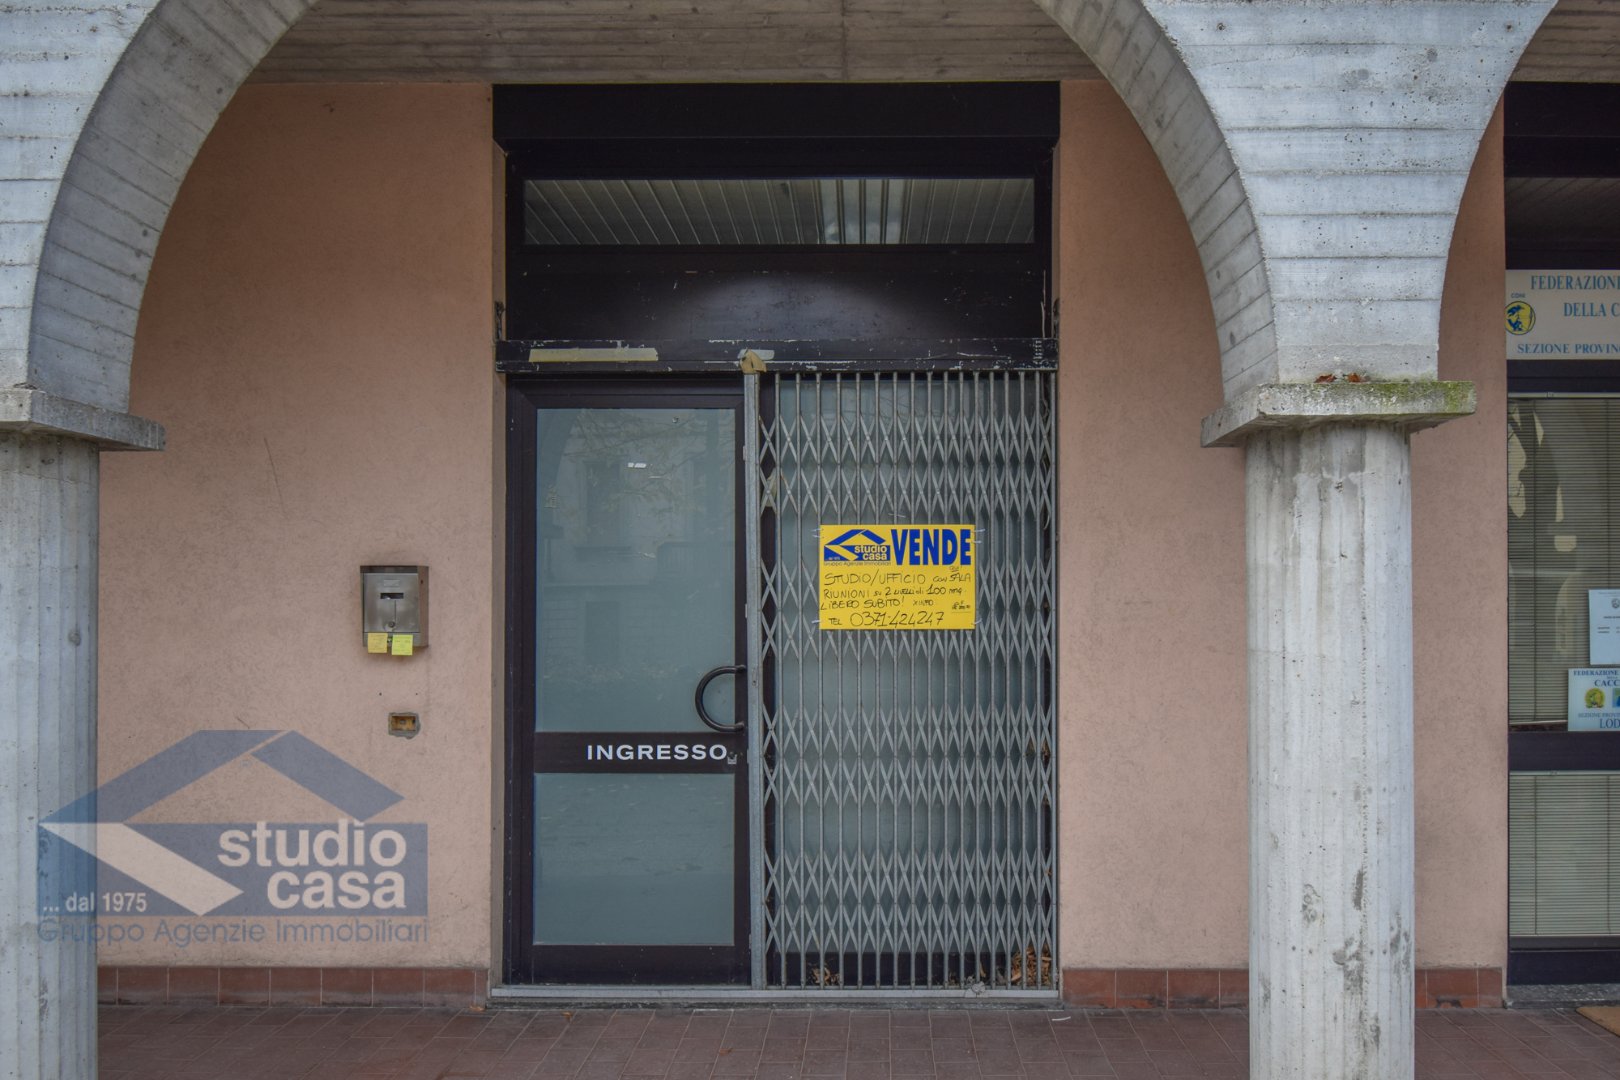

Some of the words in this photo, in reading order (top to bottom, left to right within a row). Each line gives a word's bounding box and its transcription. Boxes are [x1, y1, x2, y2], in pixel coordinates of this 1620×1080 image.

[1563, 302, 1607, 317] DELLA
[1517, 343, 1570, 354] SEZIONE
[1574, 343, 1620, 354] PROVIN
[854, 545, 888, 554] studio
[890, 528, 971, 566] VENDE
[862, 553, 888, 561] casa
[823, 588, 870, 600] RIUNIONI
[885, 587, 891, 596] 2
[926, 583, 946, 595] 100
[587, 744, 728, 760] INGRESSO
